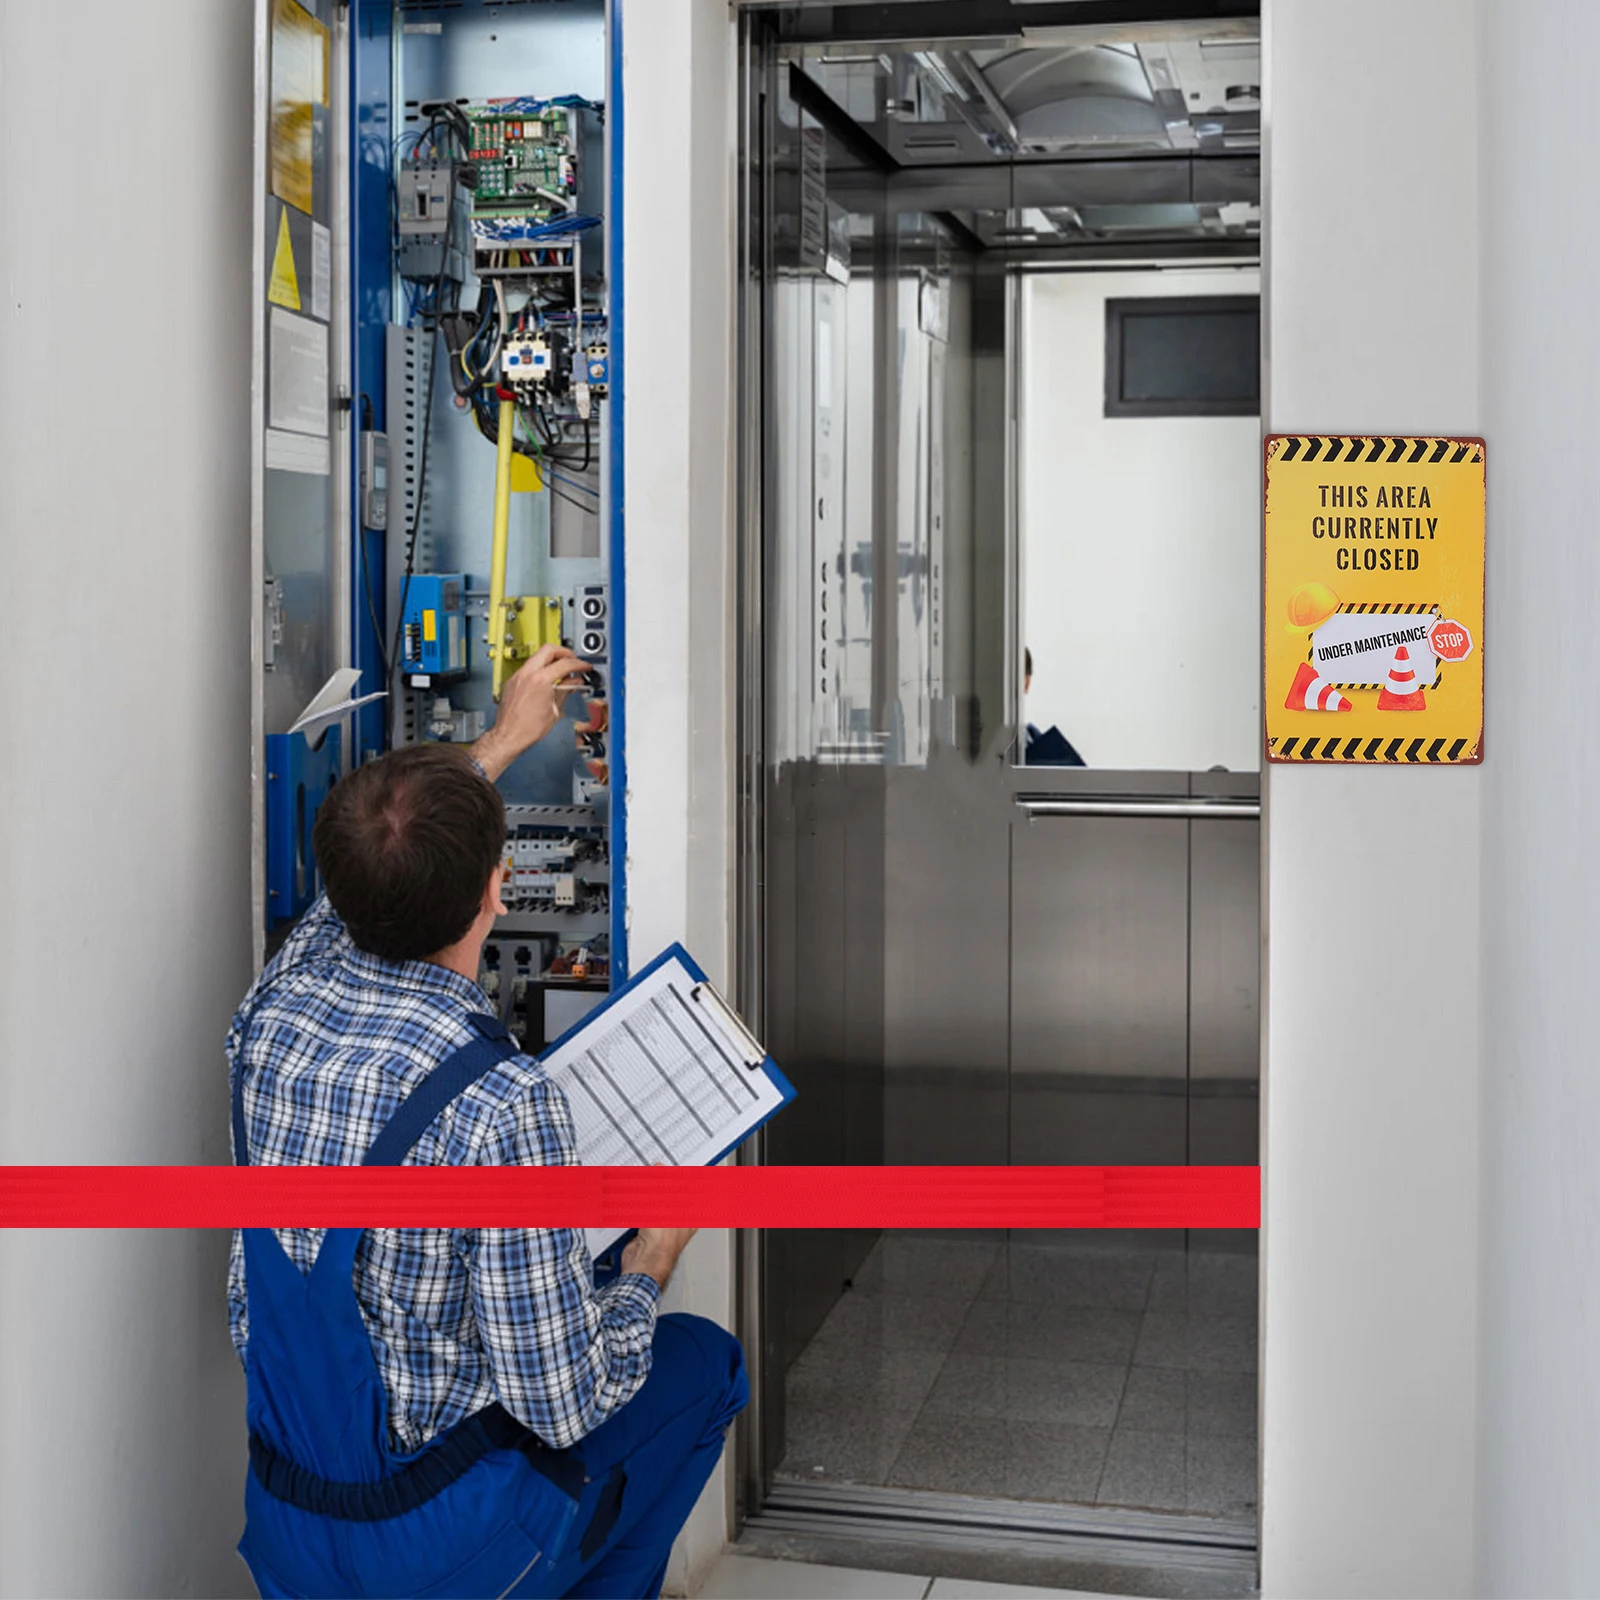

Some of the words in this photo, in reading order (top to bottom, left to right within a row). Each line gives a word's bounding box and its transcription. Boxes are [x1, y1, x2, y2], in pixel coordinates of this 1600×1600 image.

[1318, 485, 1368, 508] THIS
[1376, 486, 1431, 508] AREA
[1312, 517, 1437, 539] CURRENTLY
[1337, 548, 1419, 570] CLOSED
[1318, 642, 1354, 661] UNDER
[1354, 626, 1427, 653] MAINTENANCE
[1435, 633, 1463, 649] STOP
